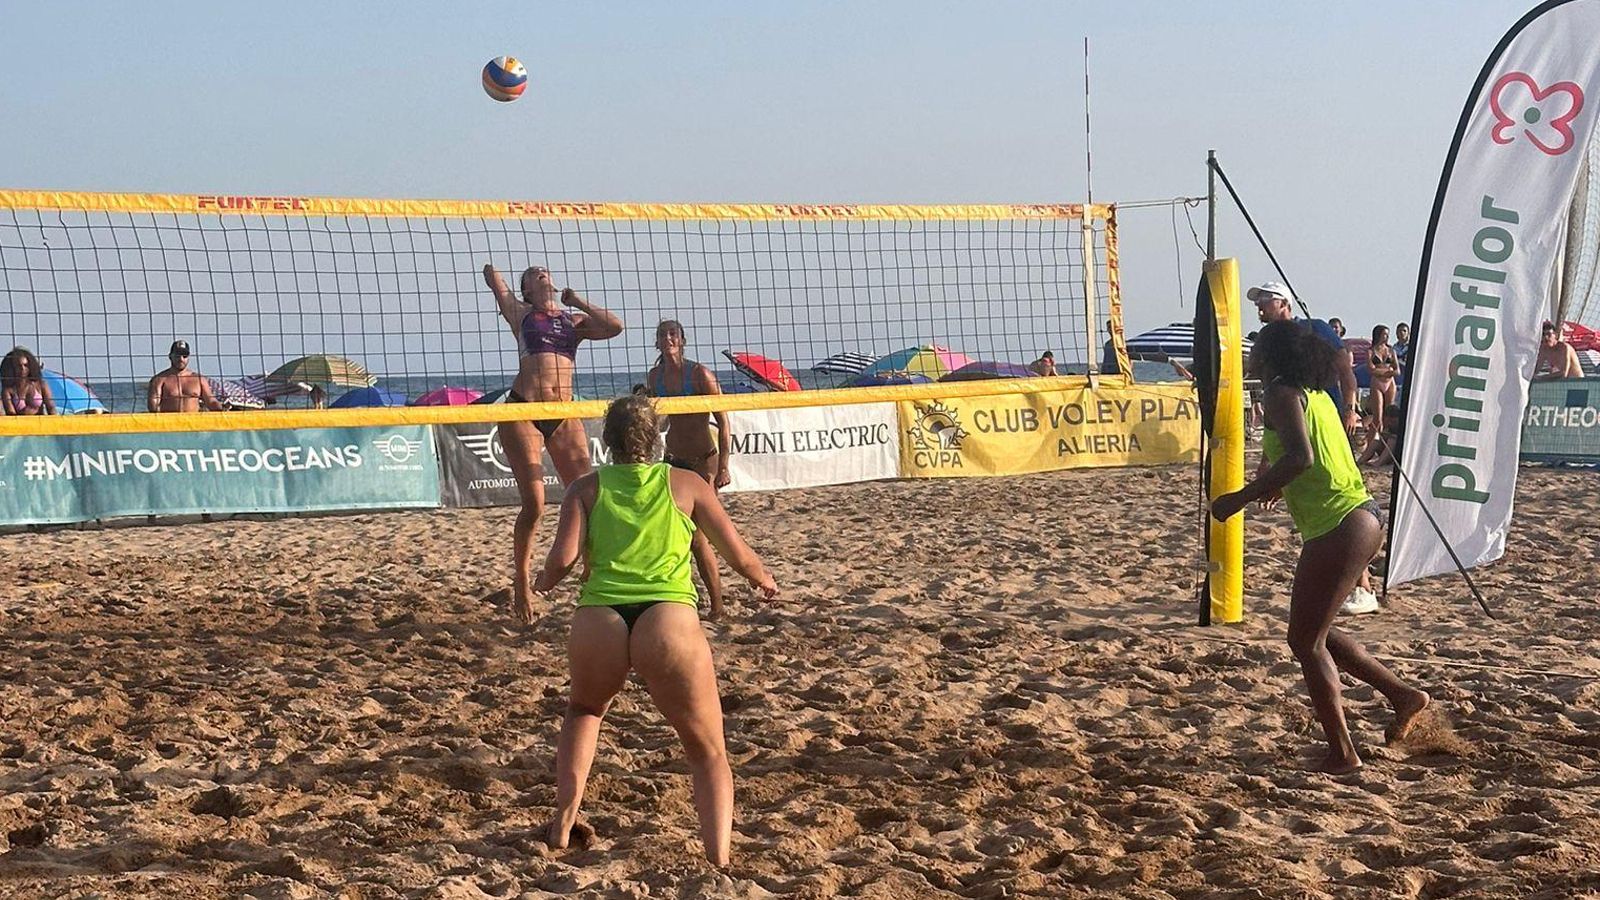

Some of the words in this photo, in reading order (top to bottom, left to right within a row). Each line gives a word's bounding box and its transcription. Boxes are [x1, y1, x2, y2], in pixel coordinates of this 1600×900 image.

[1431, 195, 1519, 504] primaflor
[973, 408, 1040, 433] CLUB
[1048, 399, 1132, 429] VOLEY
[729, 432, 786, 454] MINI
[792, 423, 890, 452] ELECTRIC
[23, 445, 363, 480] #MINIFORTHEOCEANS
[914, 451, 963, 468] CVPA
